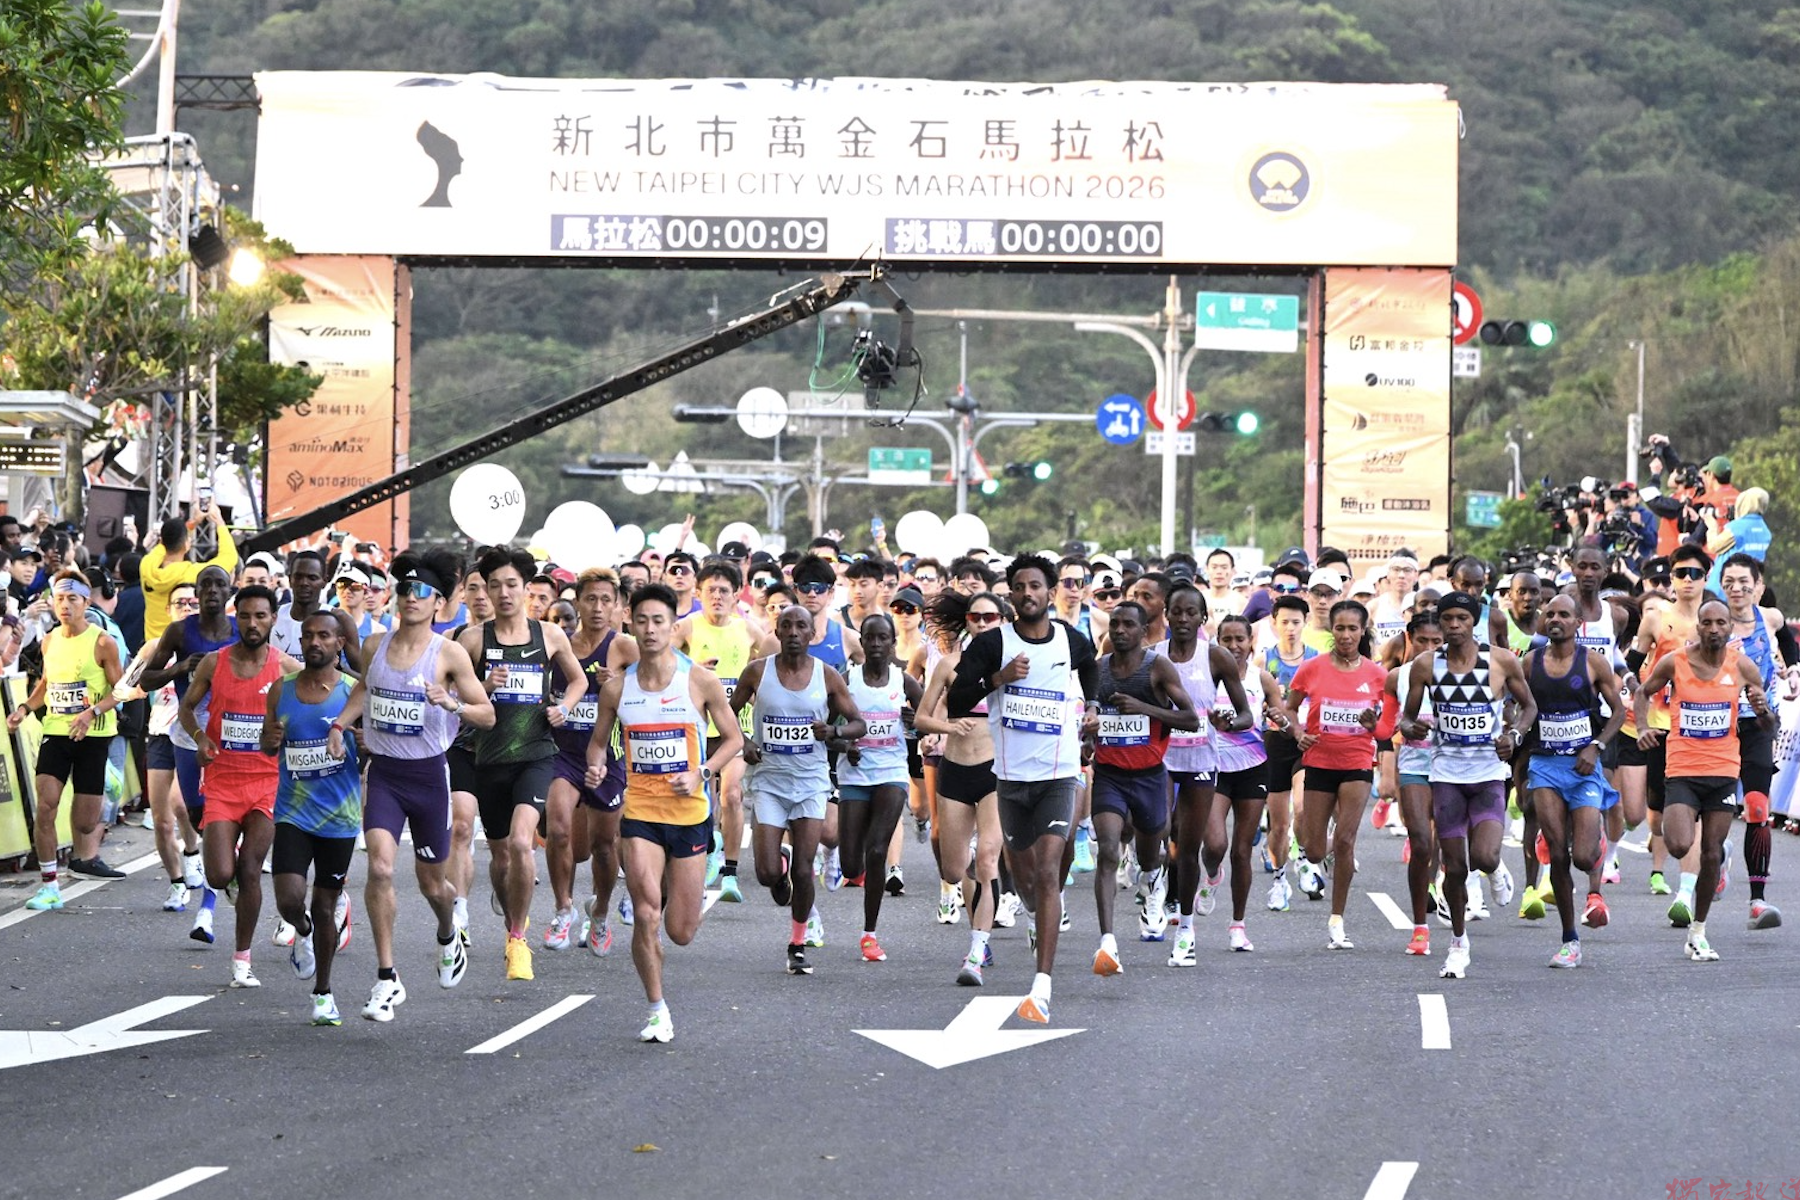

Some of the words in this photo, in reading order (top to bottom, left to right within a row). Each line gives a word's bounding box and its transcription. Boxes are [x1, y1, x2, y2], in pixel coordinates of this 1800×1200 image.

[551, 114, 1165, 162] 新北市萬金石馬拉松
[550, 171, 620, 192] NEW
[632, 171, 726, 193] TAIPEI
[738, 173, 804, 195] CITY
[818, 174, 883, 197] WJS
[895, 174, 1073, 198] MARATHON
[1086, 175, 1165, 199] 2026
[558, 216, 662, 250] 馬拉松
[665, 219, 826, 250] 00:00:09
[894, 219, 996, 255] 挑戰馬
[1001, 221, 1161, 255] 00:00:00
[319, 326, 371, 337] Mizuno
[1380, 378, 1415, 387] UV100
[289, 440, 364, 453] aminoMax
[309, 476, 373, 488] NOTORIOUS
[489, 489, 520, 510] 3:00
[51, 690, 84, 704] 12475
[373, 704, 419, 721] HUANG
[1005, 700, 1060, 720] HAILEMICAEL
[1102, 720, 1143, 733] SHAKU
[1442, 715, 1486, 731] 10135
[1684, 714, 1726, 727] TESFAY
[767, 726, 809, 740] 10132
[866, 723, 893, 735] GAT
[1542, 723, 1588, 738] SOLOMON
[288, 752, 342, 767] MISGANA
[636, 746, 676, 759] CHOU
